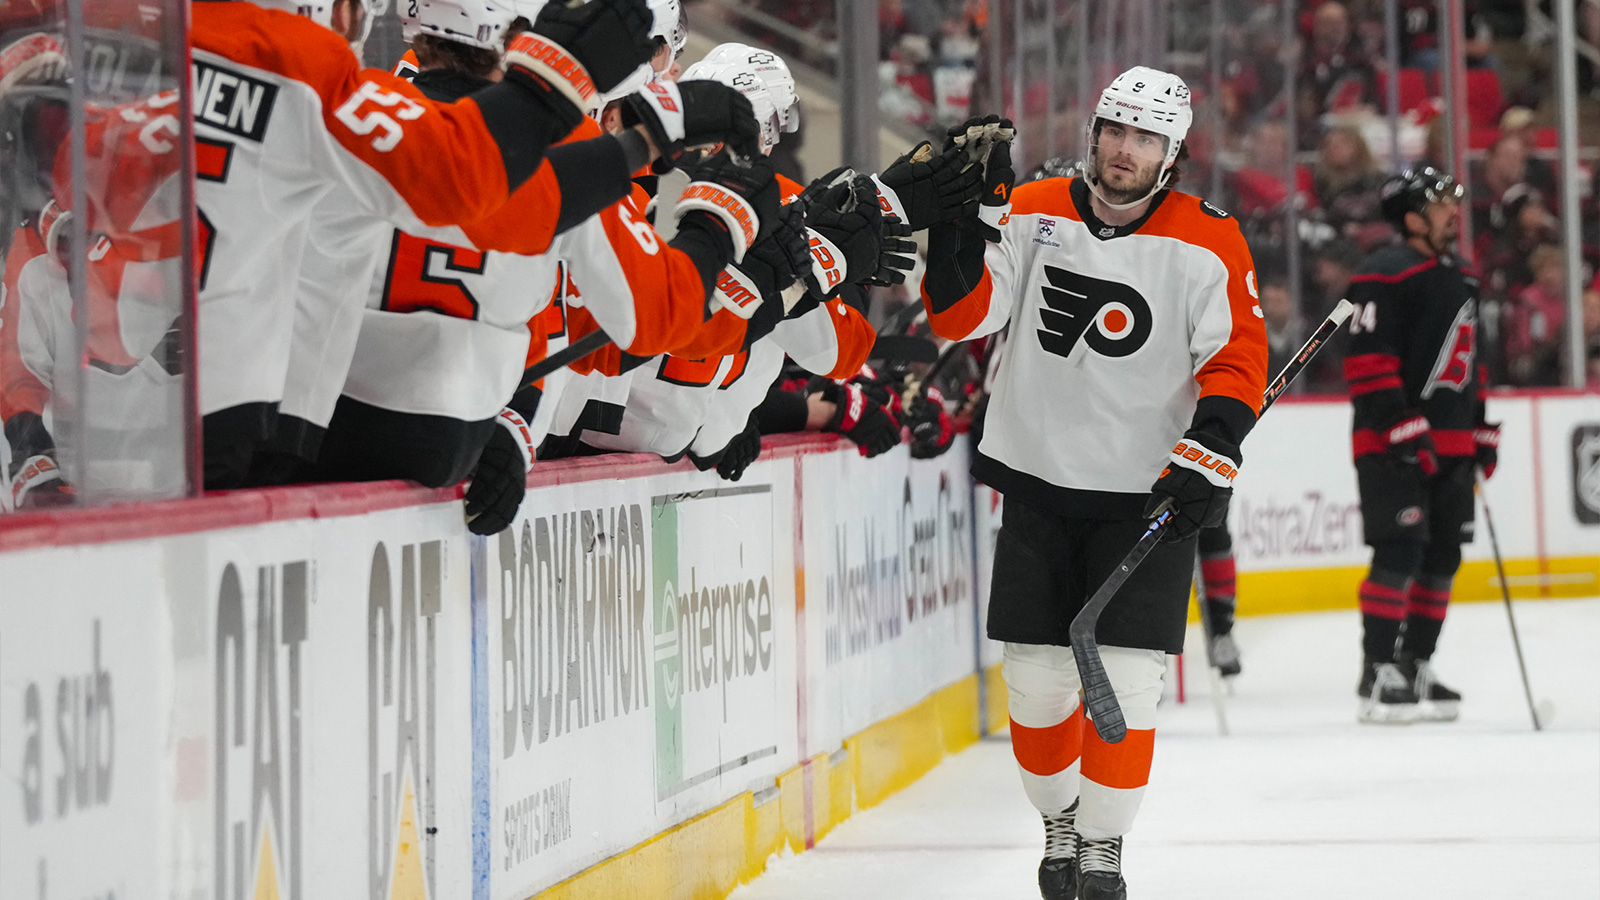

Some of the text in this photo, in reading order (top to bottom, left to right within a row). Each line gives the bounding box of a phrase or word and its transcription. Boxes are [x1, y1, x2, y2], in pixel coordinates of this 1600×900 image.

[1115, 101, 1144, 112] BAUER
[1171, 442, 1239, 483] BAUER
[498, 503, 649, 761] BODYARMOR
[56, 618, 114, 821] sub
[367, 540, 442, 900] CAT
[504, 777, 572, 872] SPORTS DRINK
